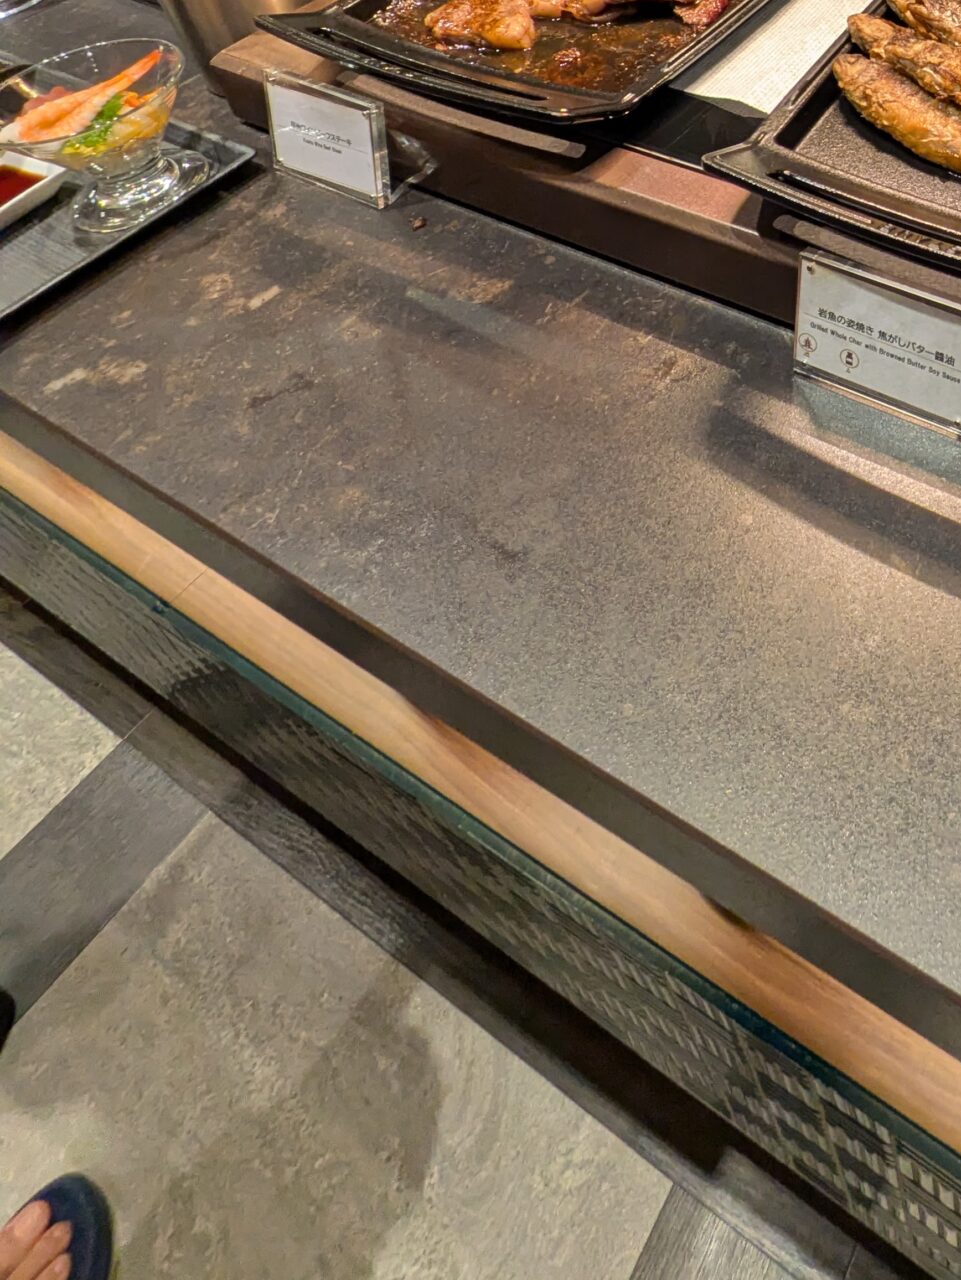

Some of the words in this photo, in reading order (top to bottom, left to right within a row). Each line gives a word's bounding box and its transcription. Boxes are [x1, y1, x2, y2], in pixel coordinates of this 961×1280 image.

[810, 321, 828, 334] Grilled
[830, 329, 847, 342] Whole
[849, 336, 862, 346] Char
[865, 342, 877, 353] with
[879, 348, 905, 363] Browned
[907, 358, 926, 371] Butter
[928, 366, 940, 377] Soy
[942, 372, 961, 384] Sauce
